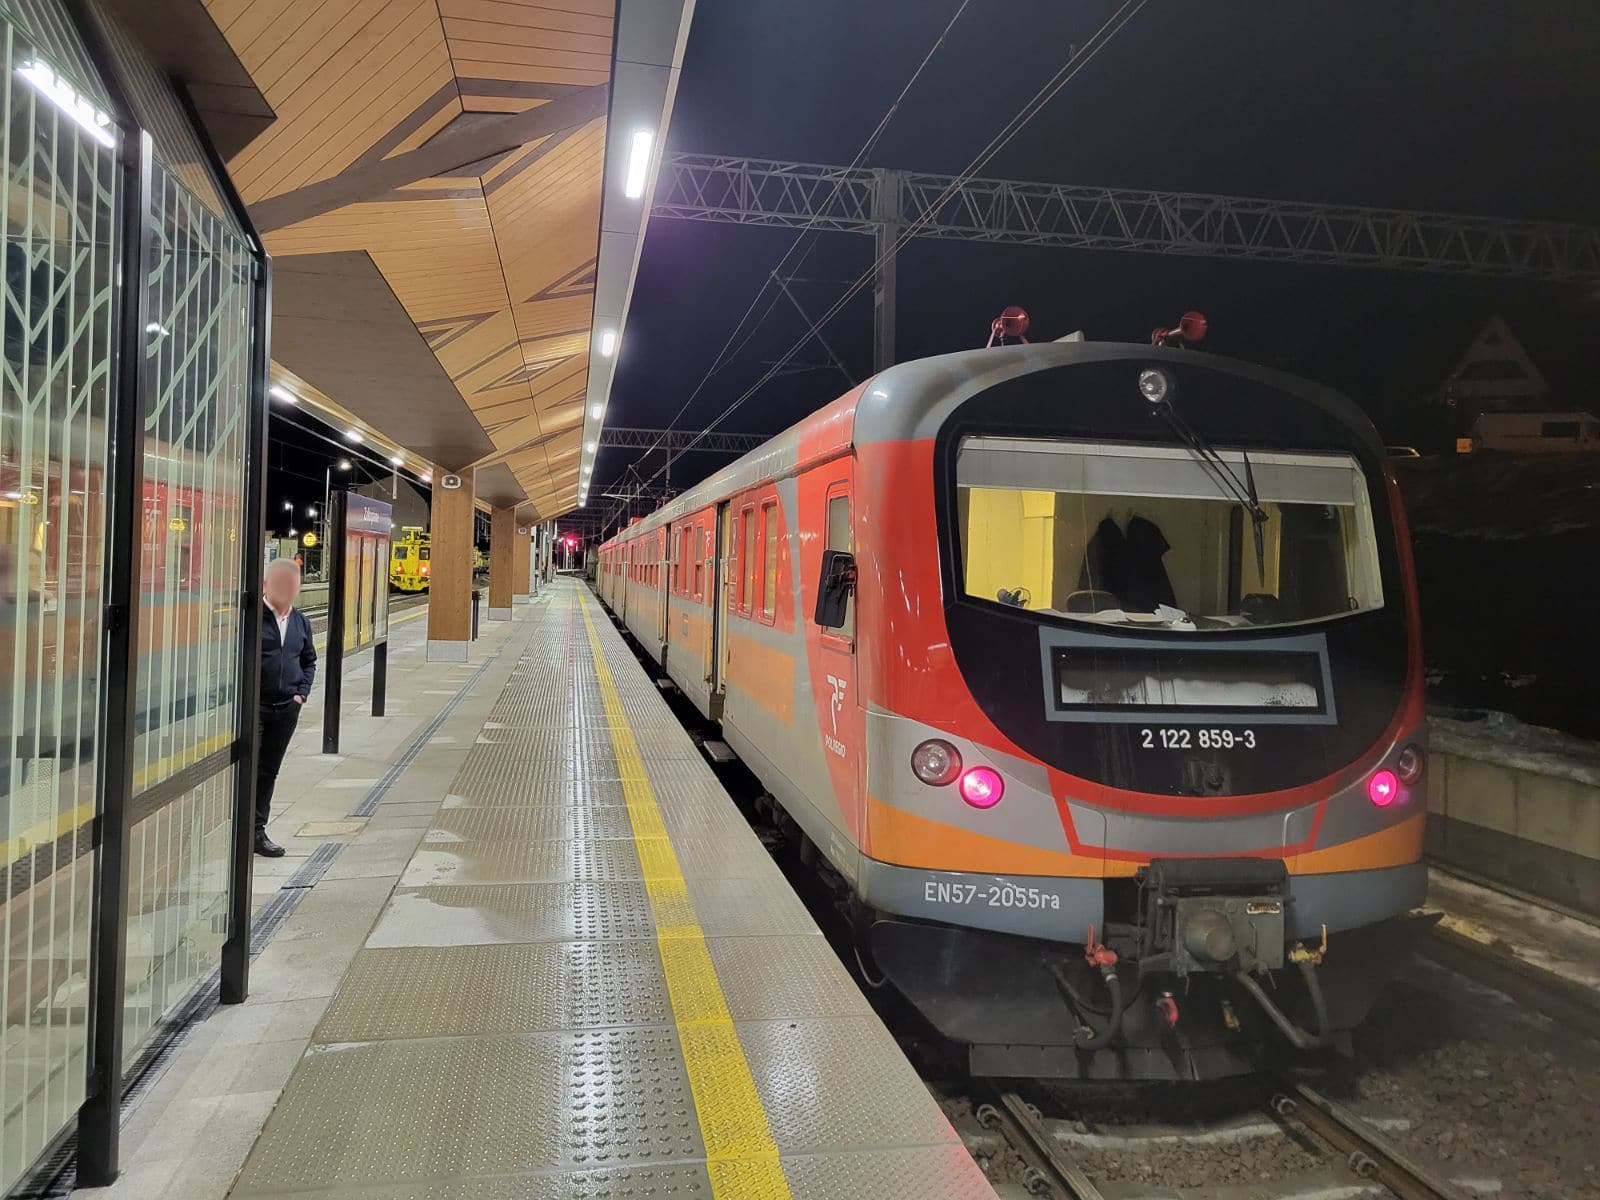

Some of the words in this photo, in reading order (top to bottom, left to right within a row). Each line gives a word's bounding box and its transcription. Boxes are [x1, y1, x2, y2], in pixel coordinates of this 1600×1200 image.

[1141, 728, 1154, 748] 2
[1159, 728, 1192, 748] 122
[1198, 729, 1256, 749] 859-3
[924, 881, 1061, 909] EN57-2055ra
